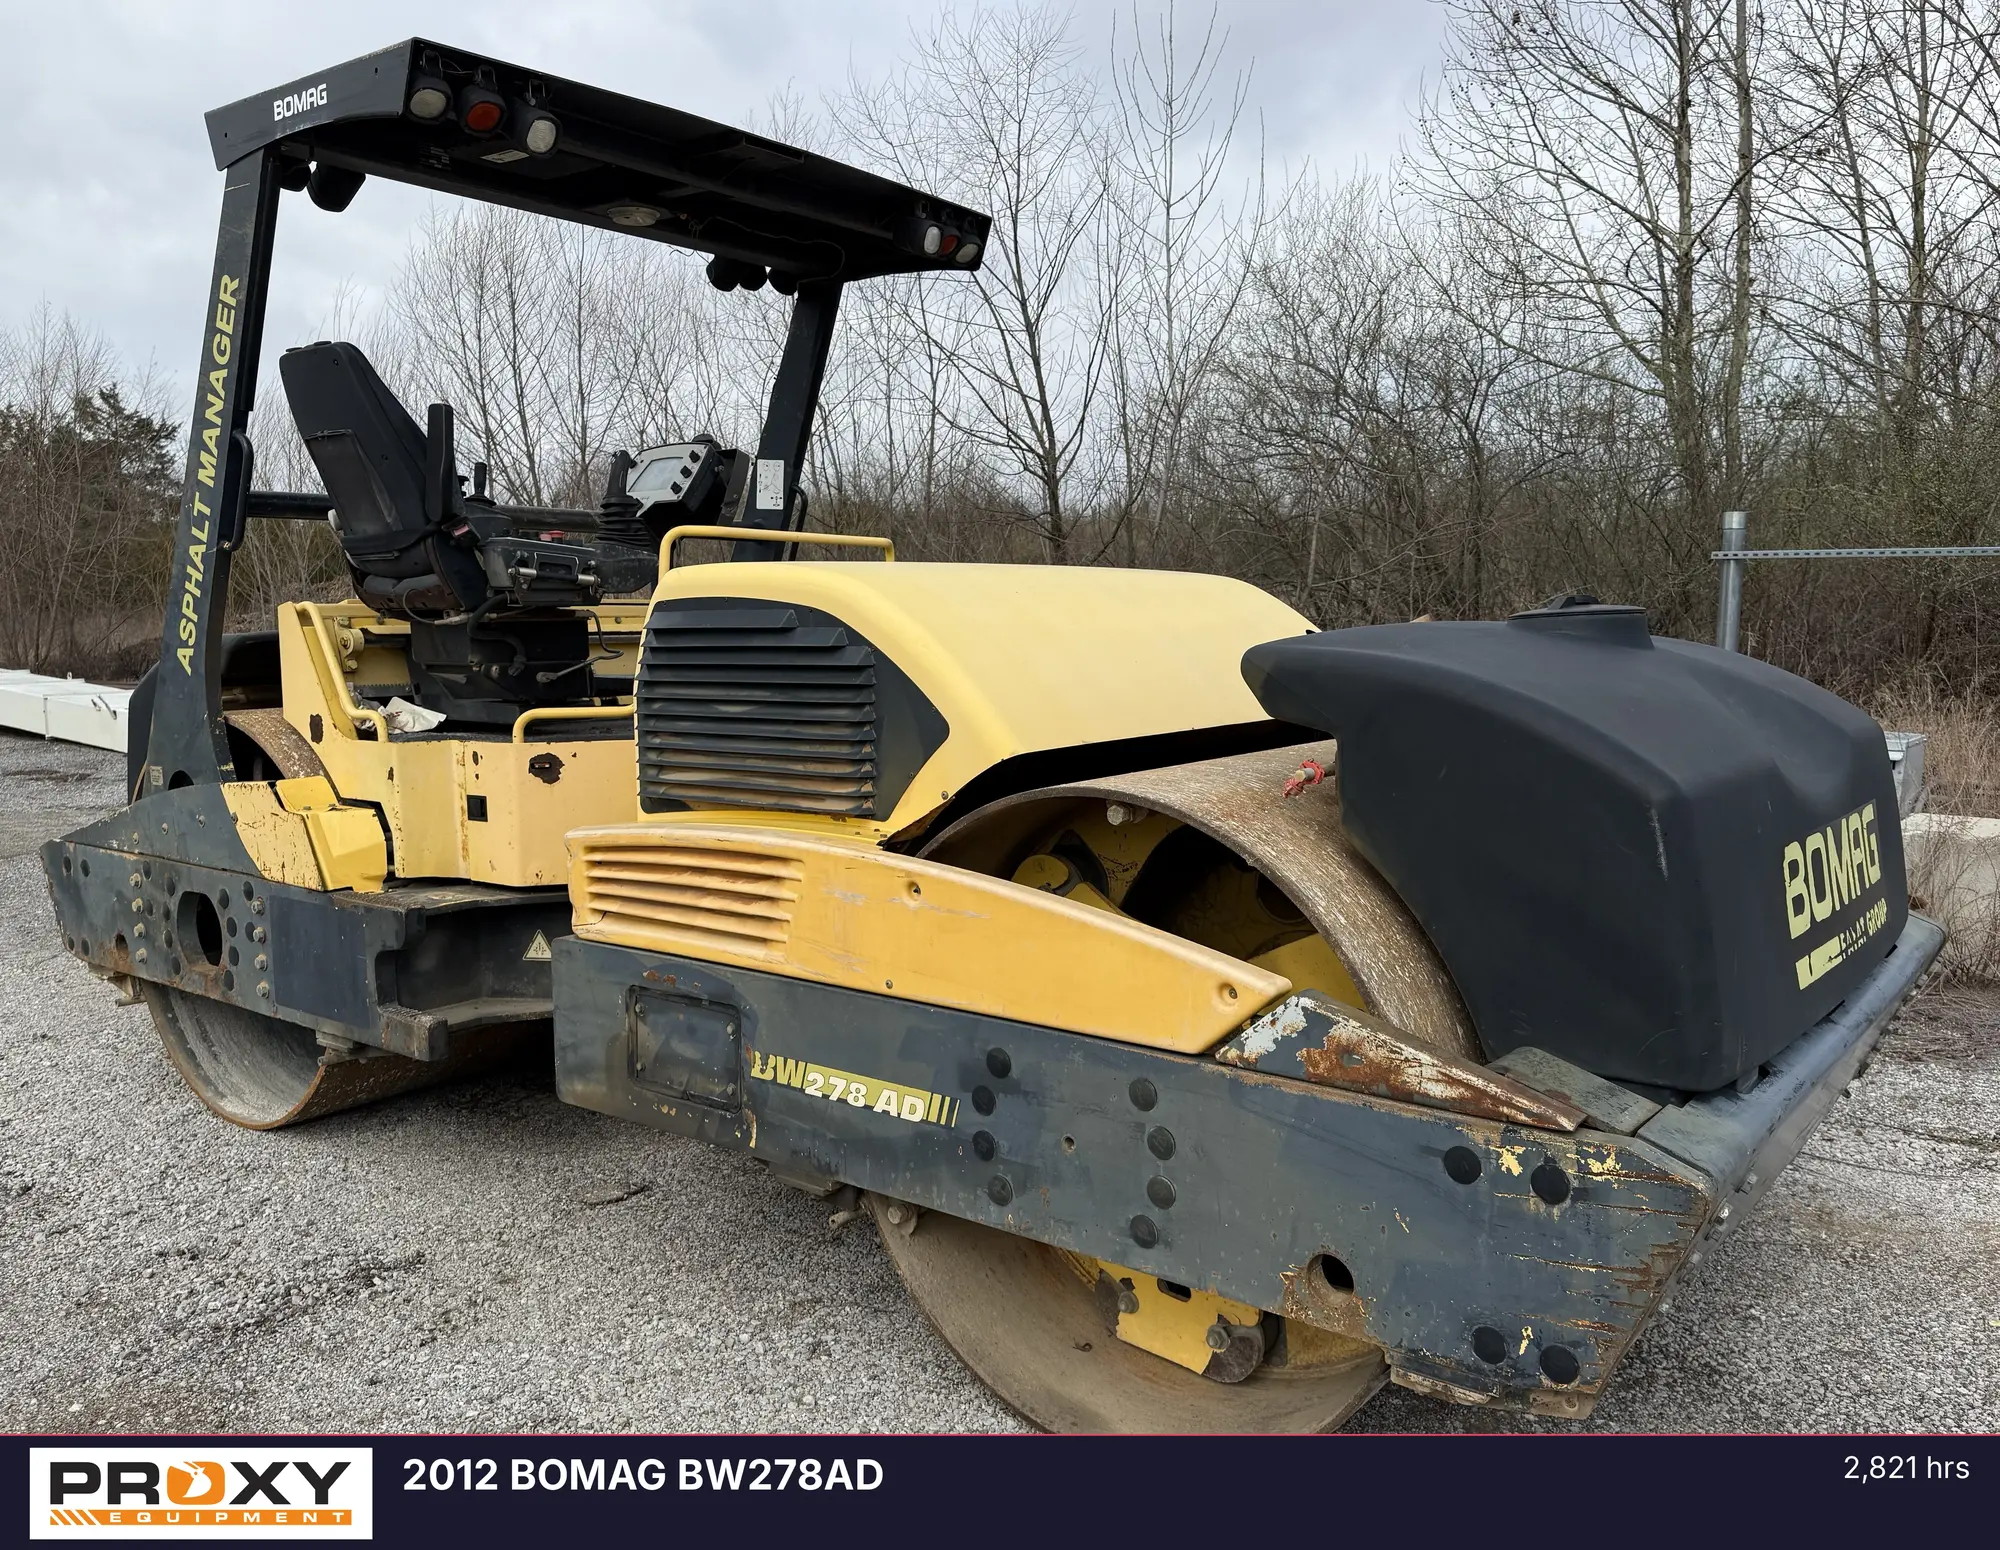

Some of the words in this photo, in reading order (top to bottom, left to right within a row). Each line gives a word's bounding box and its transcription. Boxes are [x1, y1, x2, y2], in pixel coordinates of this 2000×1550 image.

[273, 83, 328, 121] BOMAG
[176, 491, 212, 677] ASPHALT
[197, 274, 240, 489] MANAGER
[1782, 803, 1881, 940] BOMAG
[1866, 897, 1888, 937] GROUP
[873, 1088, 926, 1122] AD
